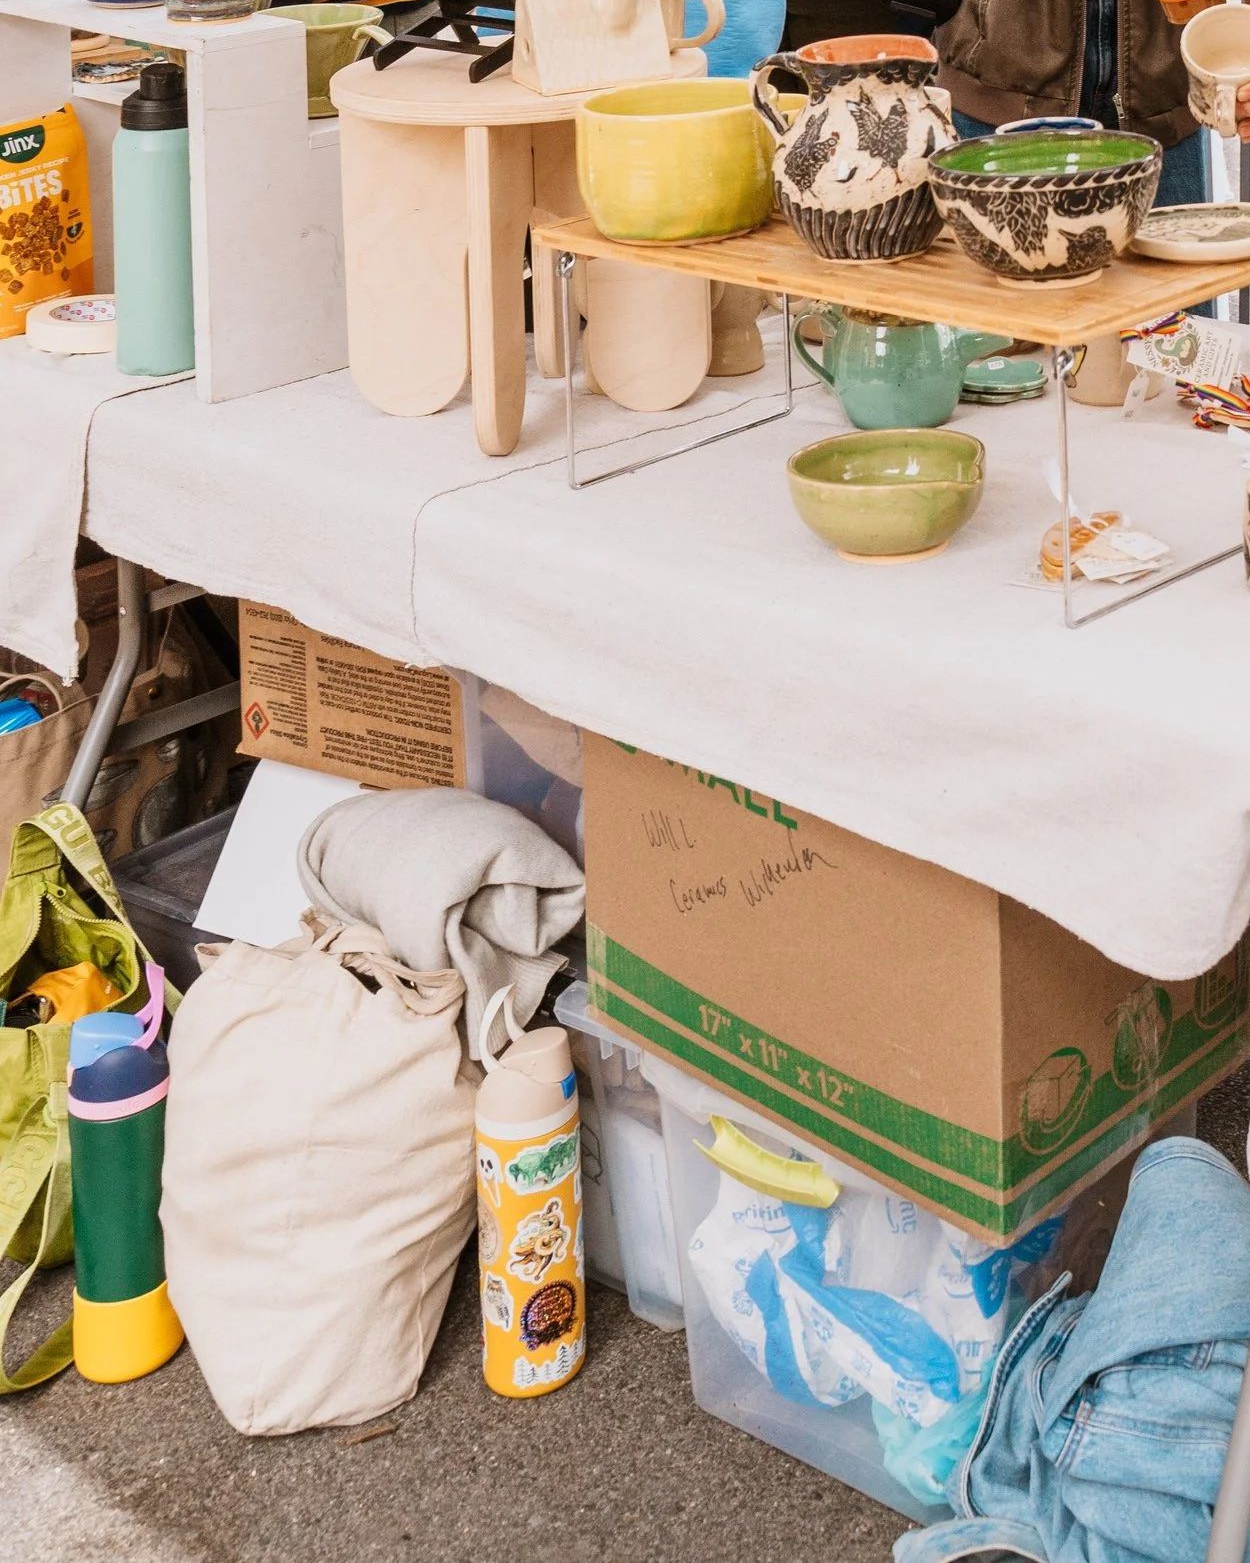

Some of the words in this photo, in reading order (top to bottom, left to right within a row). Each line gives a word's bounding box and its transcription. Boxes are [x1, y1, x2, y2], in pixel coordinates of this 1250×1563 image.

[698, 1005, 731, 1036] 17"
[739, 1033, 754, 1057] x
[758, 1038, 788, 1071] 11"
[797, 1066, 812, 1089] x
[817, 1069, 854, 1107] 12"
